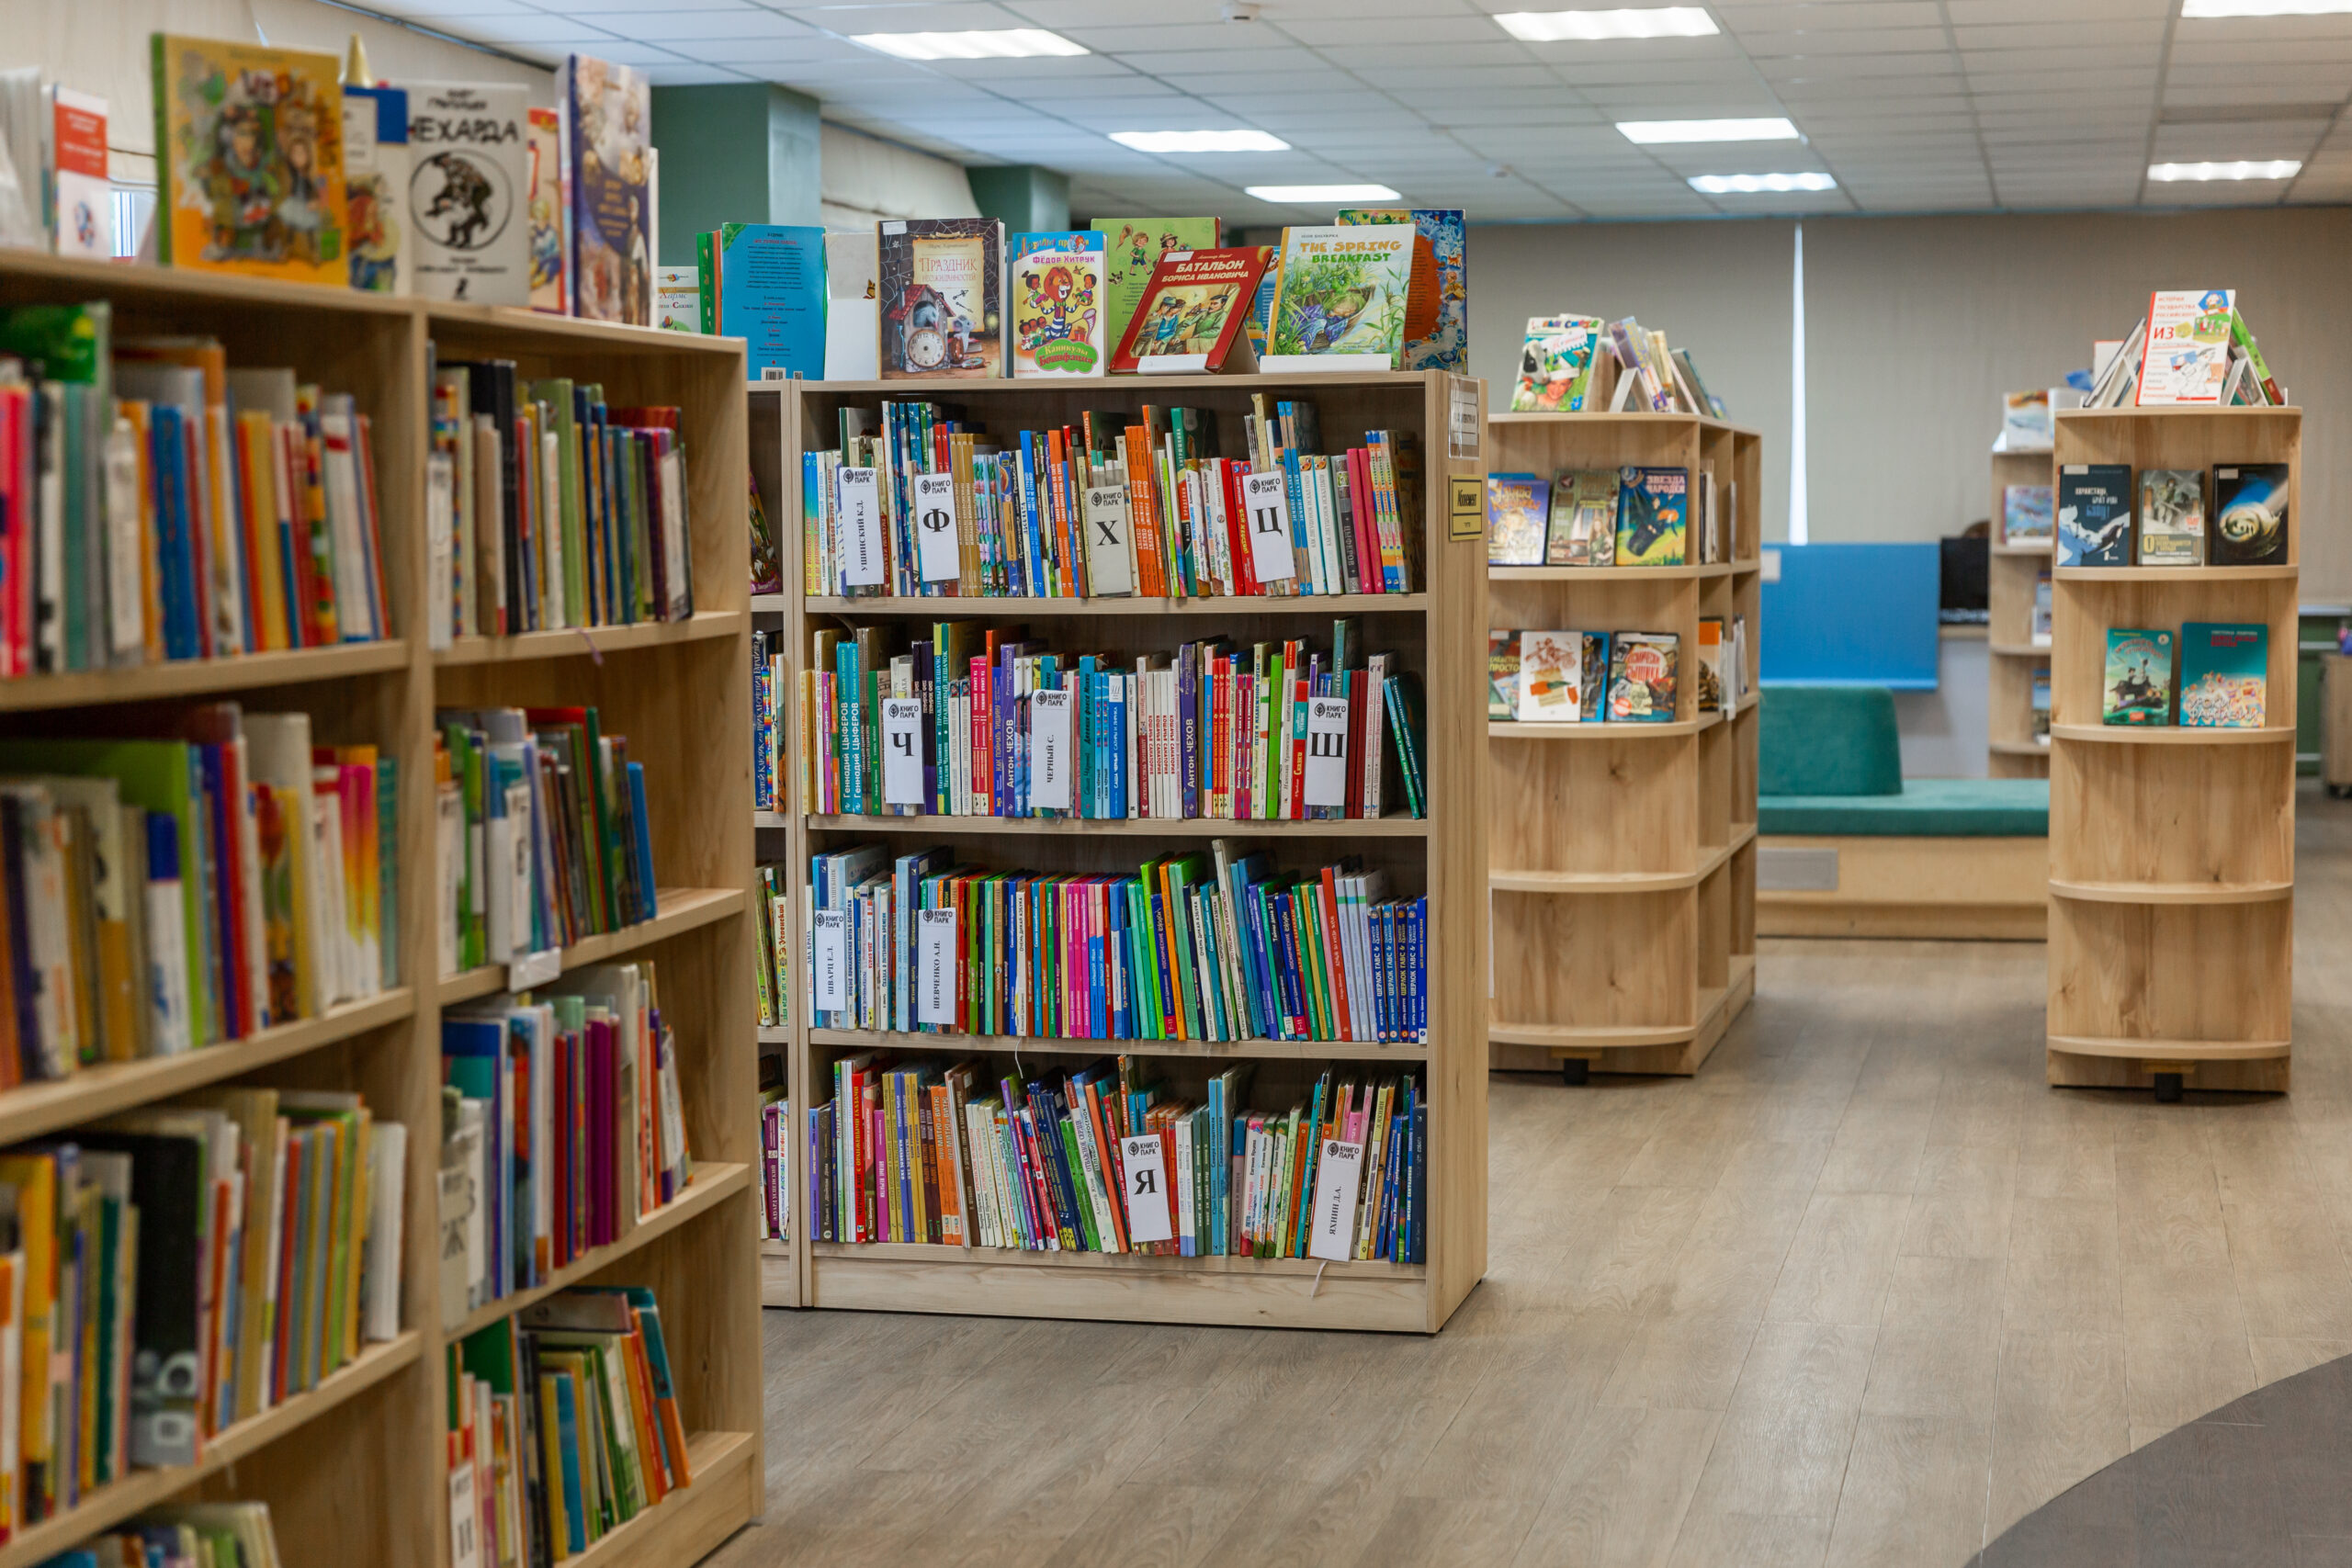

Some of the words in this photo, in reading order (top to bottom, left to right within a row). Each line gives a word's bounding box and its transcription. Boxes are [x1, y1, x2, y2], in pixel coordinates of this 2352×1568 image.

[1300, 243, 1327, 253] THE
[1333, 241, 1402, 253] SPRING
[1312, 253, 1391, 264] BREAKFAST
[1064, 255, 1095, 264] ХИТРУК
[1176, 260, 1245, 273] БАТАЛЬОН
[1196, 271, 1249, 280] ИВАНОВИЧА
[660, 288, 688, 299] Хармс
[1039, 354, 1092, 366] Бонифация
[1045, 344, 1088, 355] Каникулы
[1261, 479, 1281, 487] КНИГО
[1646, 475, 1685, 484] ЗВЕЗДА
[1102, 491, 1123, 500] КНИГО
[855, 500, 865, 516] К.Д.
[1289, 499, 1297, 522] ЗИМНИЕ
[922, 508, 950, 533] Ф
[1253, 505, 1283, 536] Ц
[856, 518, 868, 571] УШИНСКИЙ
[1096, 519, 1121, 547] Х
[1344, 525, 1354, 566] ЦЫФЕРОВ
[753, 641, 762, 674] БУРАТИНО
[754, 675, 763, 730] ПРИКЛЮЧЕНИЯ
[841, 702, 850, 750] ЦЫФЕРОВ
[852, 702, 860, 750] ЦЫФЕРОВ
[891, 732, 915, 757] Ч
[994, 731, 1002, 757] ПОЙМАТЬ
[1046, 734, 1054, 743] С.
[1310, 733, 1343, 758] Ш
[1294, 751, 1303, 775] Сказки
[842, 753, 851, 798] Геннадий
[757, 773, 767, 804] ЗОЛОТОЙ
[825, 915, 844, 923] КНИГО
[1216, 919, 1224, 962] СКОРОГОВОРОЧНАЯ
[1075, 1120, 1084, 1140] СЕРДЦЕ
[1080, 1141, 1091, 1172] ОТВАЖНОЕ
[1339, 1145, 1360, 1154] КНИГО
[1134, 1168, 1159, 1195] Я
[1333, 1186, 1341, 1202] Д.А.
[1329, 1203, 1340, 1235] ЯХНИН
